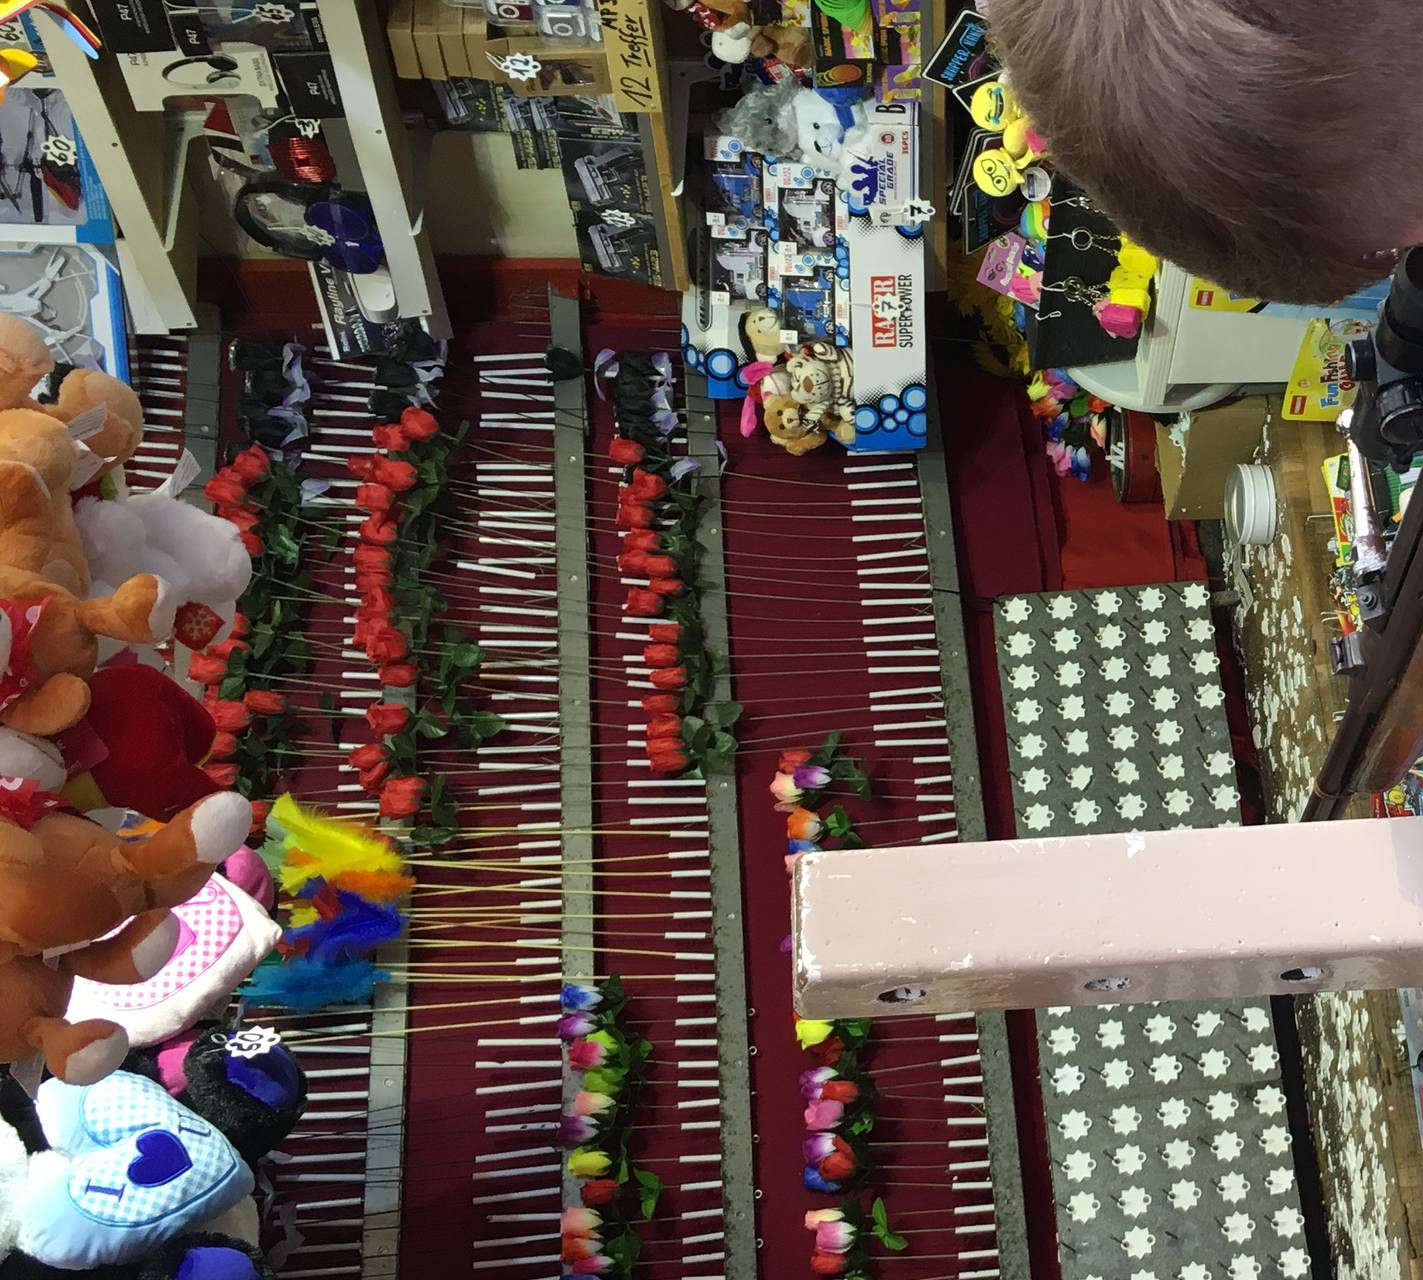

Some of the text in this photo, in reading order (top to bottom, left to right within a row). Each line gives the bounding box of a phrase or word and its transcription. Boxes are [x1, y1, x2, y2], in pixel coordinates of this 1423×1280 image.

[116, 3, 133, 21] P47
[257, 5, 285, 20] 65
[185, 29, 201, 45] P47
[509, 58, 530, 76] 12
[618, 14, 653, 108] 12 Treffer
[305, 81, 321, 96] P47
[875, 103, 906, 114] B
[50, 139, 71, 162] 60
[878, 157, 887, 205] SPECIAL
[886, 151, 894, 190] GRADE
[909, 204, 927, 217] 7
[325, 278, 347, 326] Rayline
[873, 278, 895, 345] RAR
[881, 301, 897, 312] 7
[899, 315, 913, 348] SUPER
[1320, 383, 1339, 408] Fun
[238, 1031, 264, 1052] 50
[177, 1111, 211, 1138] U
[84, 1178, 126, 1202] I
